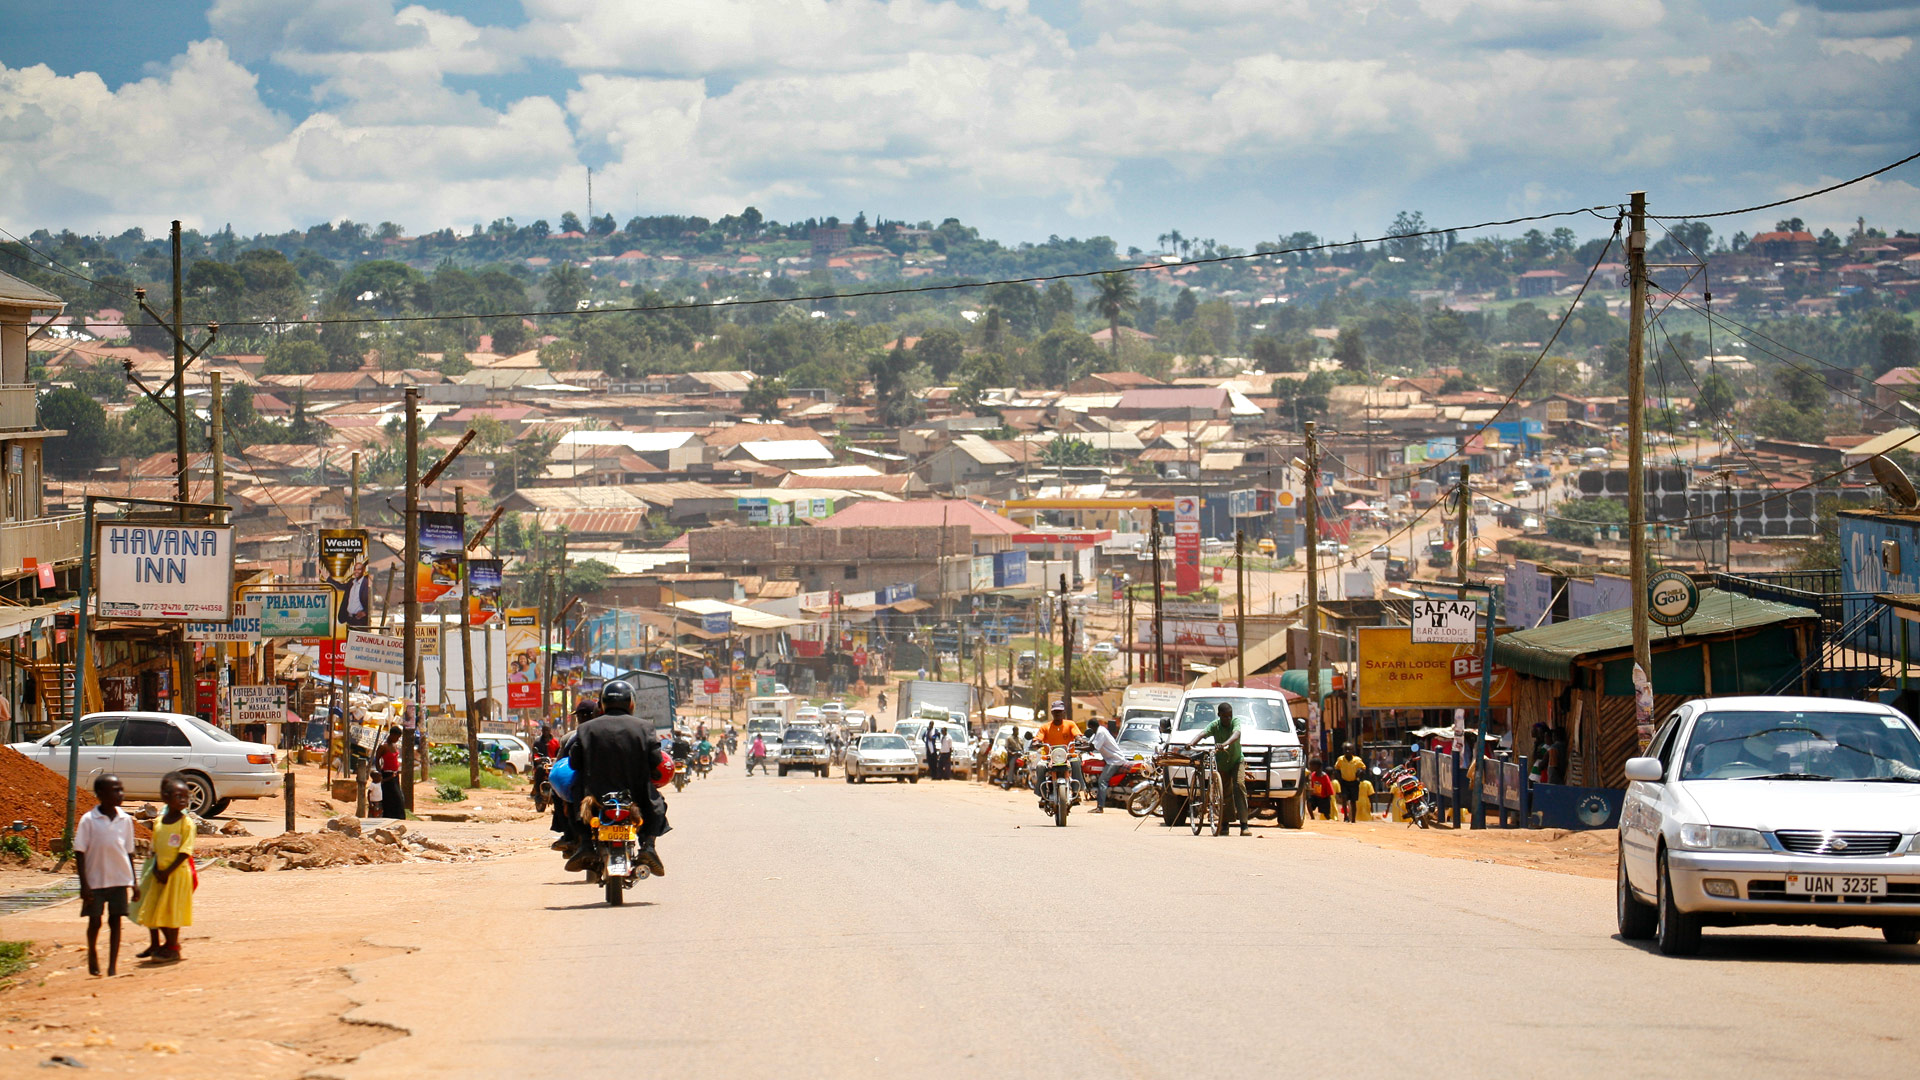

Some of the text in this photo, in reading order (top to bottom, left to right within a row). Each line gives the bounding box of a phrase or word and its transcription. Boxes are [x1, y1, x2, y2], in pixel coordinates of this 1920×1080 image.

[110, 528, 217, 556] HAVANA
[136, 557, 186, 584] INN
[266, 594, 328, 609] PHARMACY
[1414, 601, 1475, 621] SAFARI
[187, 622, 222, 632] GUEST
[226, 618, 260, 632] HOUSE
[1366, 660, 1406, 669] SAFARI
[1388, 672, 1397, 681] &
[267, 687, 285, 696] CLINIC
[1805, 877, 1878, 893] UAN 323E
